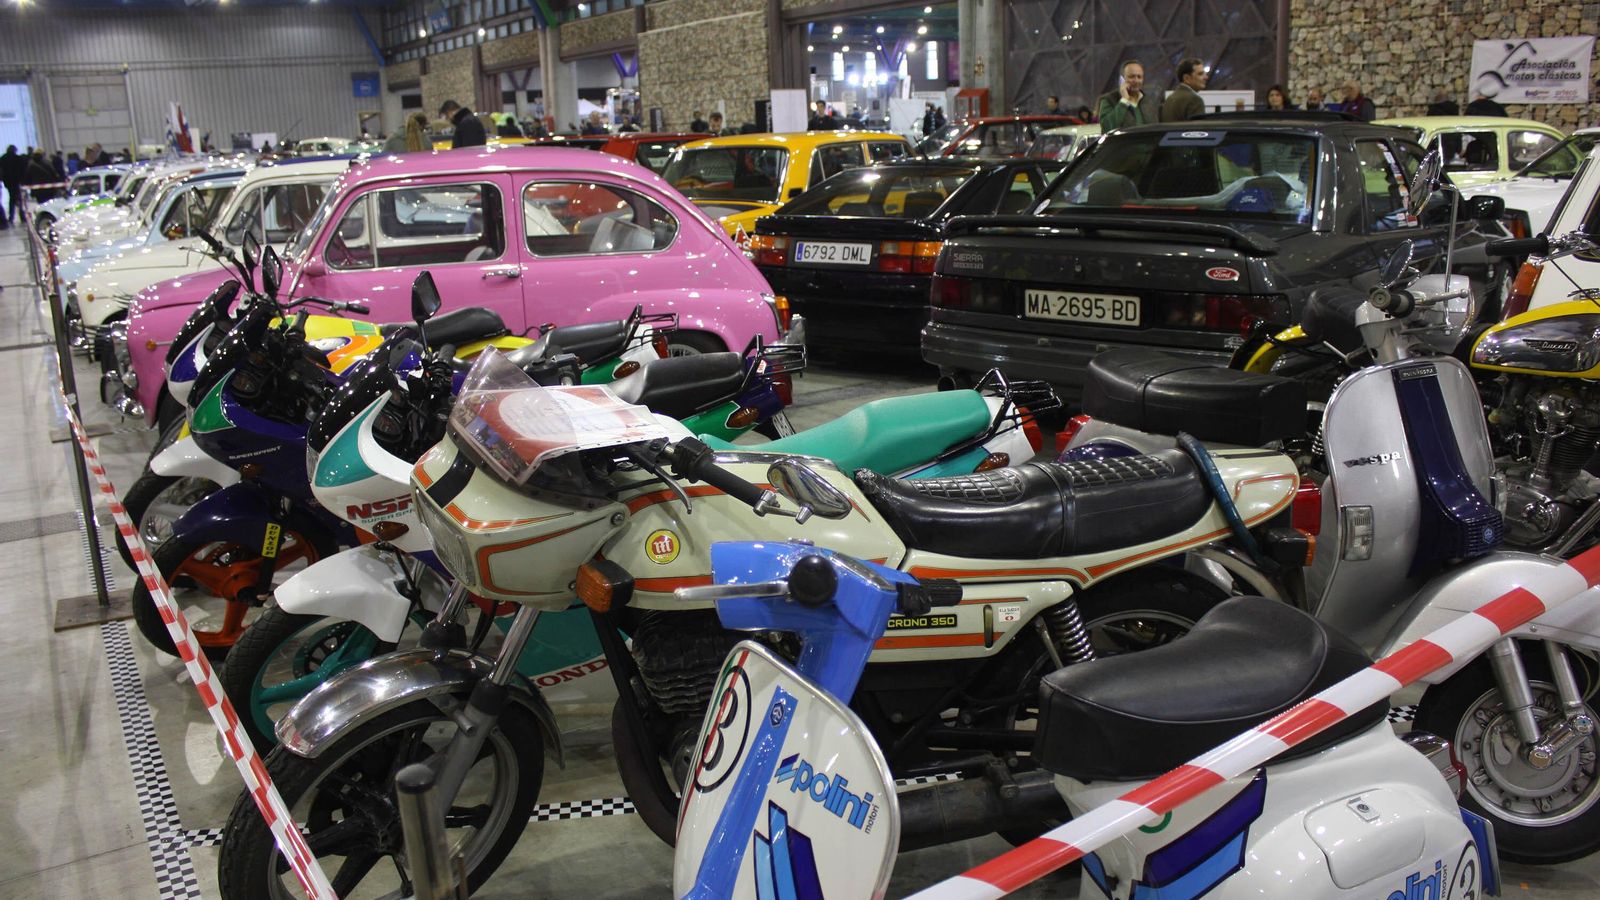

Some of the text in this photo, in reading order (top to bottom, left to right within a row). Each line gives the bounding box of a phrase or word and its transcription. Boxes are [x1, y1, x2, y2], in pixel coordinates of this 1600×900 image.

[1511, 58, 1576, 73] Asociación
[1505, 69, 1582, 80] motos clásicas
[803, 245, 867, 262] 6792 DML
[1212, 269, 1232, 279] Ford
[1541, 341, 1572, 350] Ducati
[1343, 451, 1402, 468] vespa
[264, 524, 279, 556] DUNLOP
[887, 616, 955, 628] CRONO 350
[702, 687, 738, 771] 3
[790, 759, 874, 830] polini
